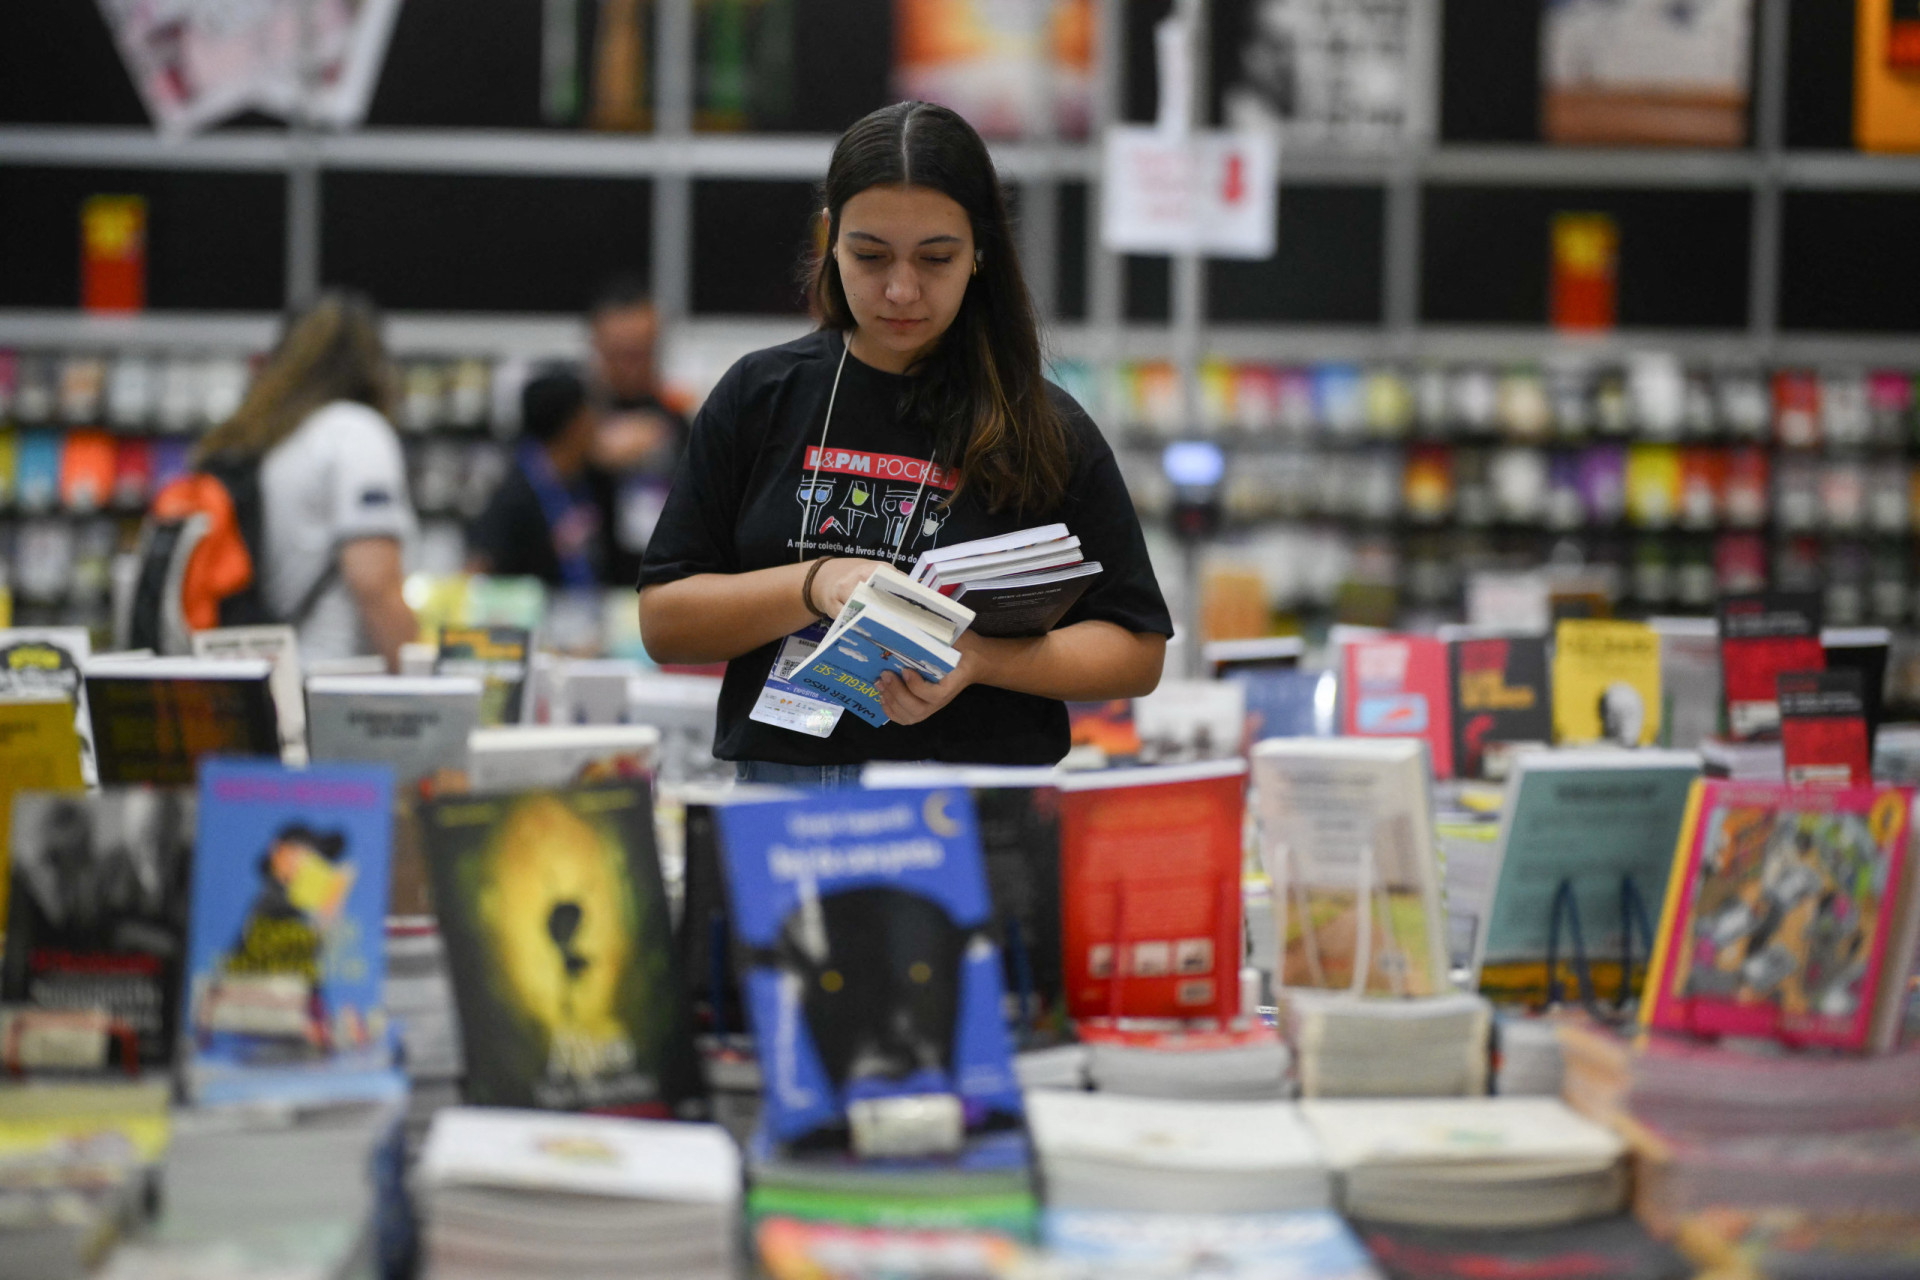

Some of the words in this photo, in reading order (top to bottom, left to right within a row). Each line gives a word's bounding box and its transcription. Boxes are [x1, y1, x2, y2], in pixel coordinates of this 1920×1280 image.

[809, 450, 871, 473] L&PM
[787, 539, 793, 548] A
[844, 545, 854, 553] de
[856, 545, 875, 556] livros
[877, 548, 885, 557] de
[887, 549, 906, 561] boso
[907, 553, 918, 563] do
[803, 678, 830, 693] RISO
[829, 689, 876, 719] WALTER
